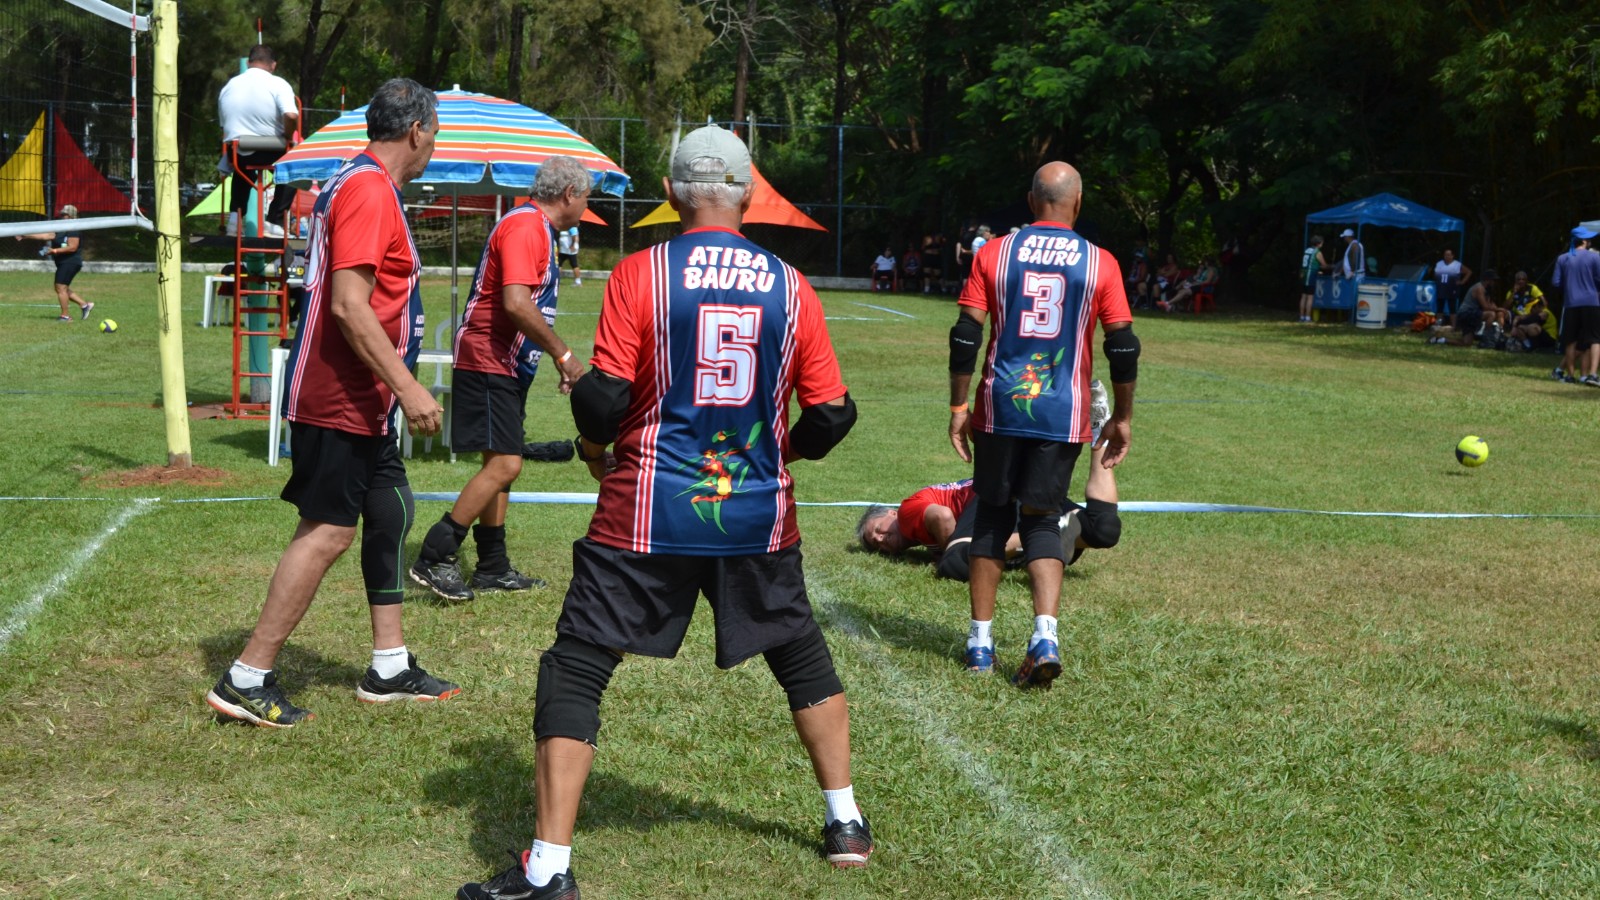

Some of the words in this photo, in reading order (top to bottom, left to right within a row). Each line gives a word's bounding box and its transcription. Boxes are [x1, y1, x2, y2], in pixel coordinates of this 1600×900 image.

[1023, 234, 1079, 252] ATIBA
[688, 246, 769, 271] ATIBA
[1017, 248, 1082, 266] BAURU
[684, 267, 776, 292] BAURU
[1019, 271, 1065, 338] 3
[693, 304, 764, 407] 5
